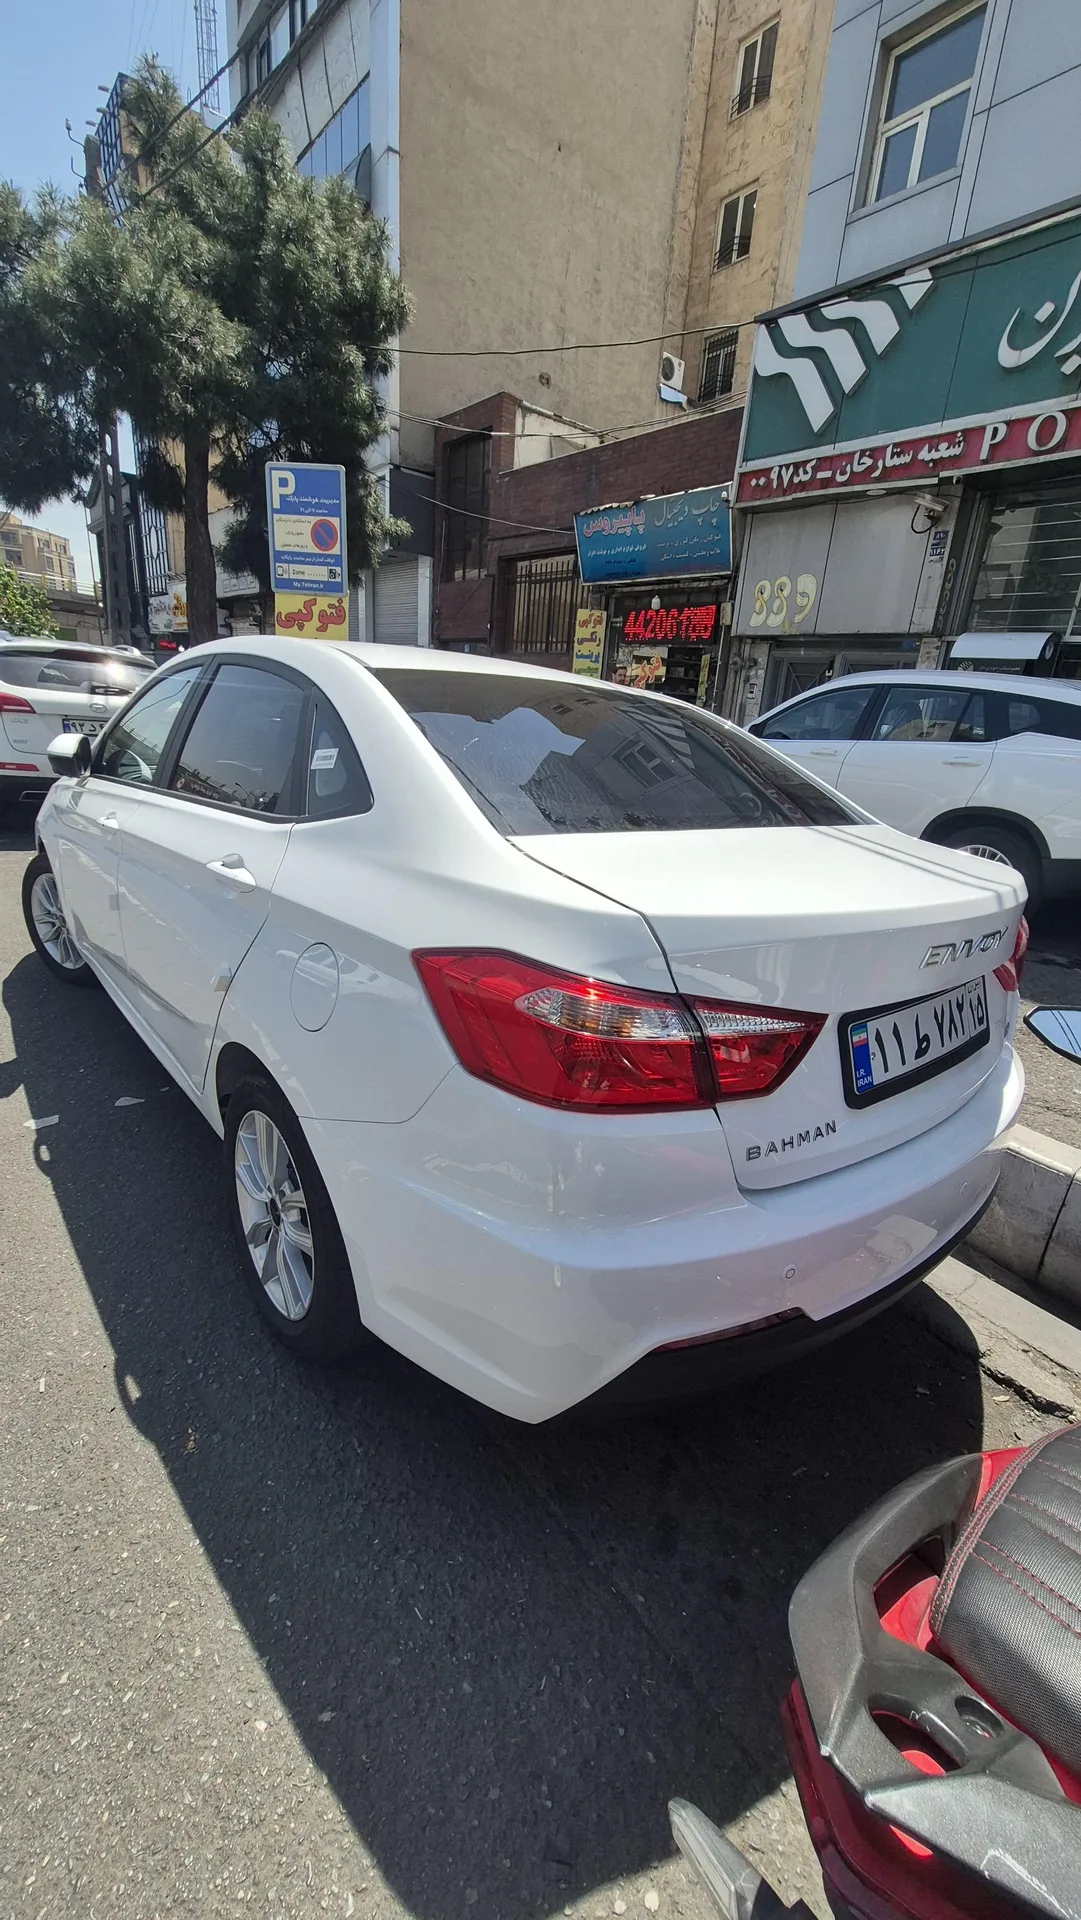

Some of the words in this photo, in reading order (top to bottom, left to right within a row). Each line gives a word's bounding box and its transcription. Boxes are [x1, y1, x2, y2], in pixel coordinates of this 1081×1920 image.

[835, 443, 913, 482] ستارخان
[917, 431, 964, 467] شعبه
[271, 470, 295, 508] P
[286, 495, 299, 503] پارک
[299, 496, 319, 504] هوشمند
[583, 505, 646, 537] پاپیروس
[691, 496, 721, 526] چاپ
[578, 612, 604, 629] فتوکپی
[577, 631, 601, 647] رنگی
[919, 926, 1009, 969] ENVOY
[969, 992, 984, 1031] ۱۵
[856, 1068, 866, 1078] I.R.
[857, 1075, 872, 1088] IRAN
[746, 1120, 837, 1162] BAHMAN
